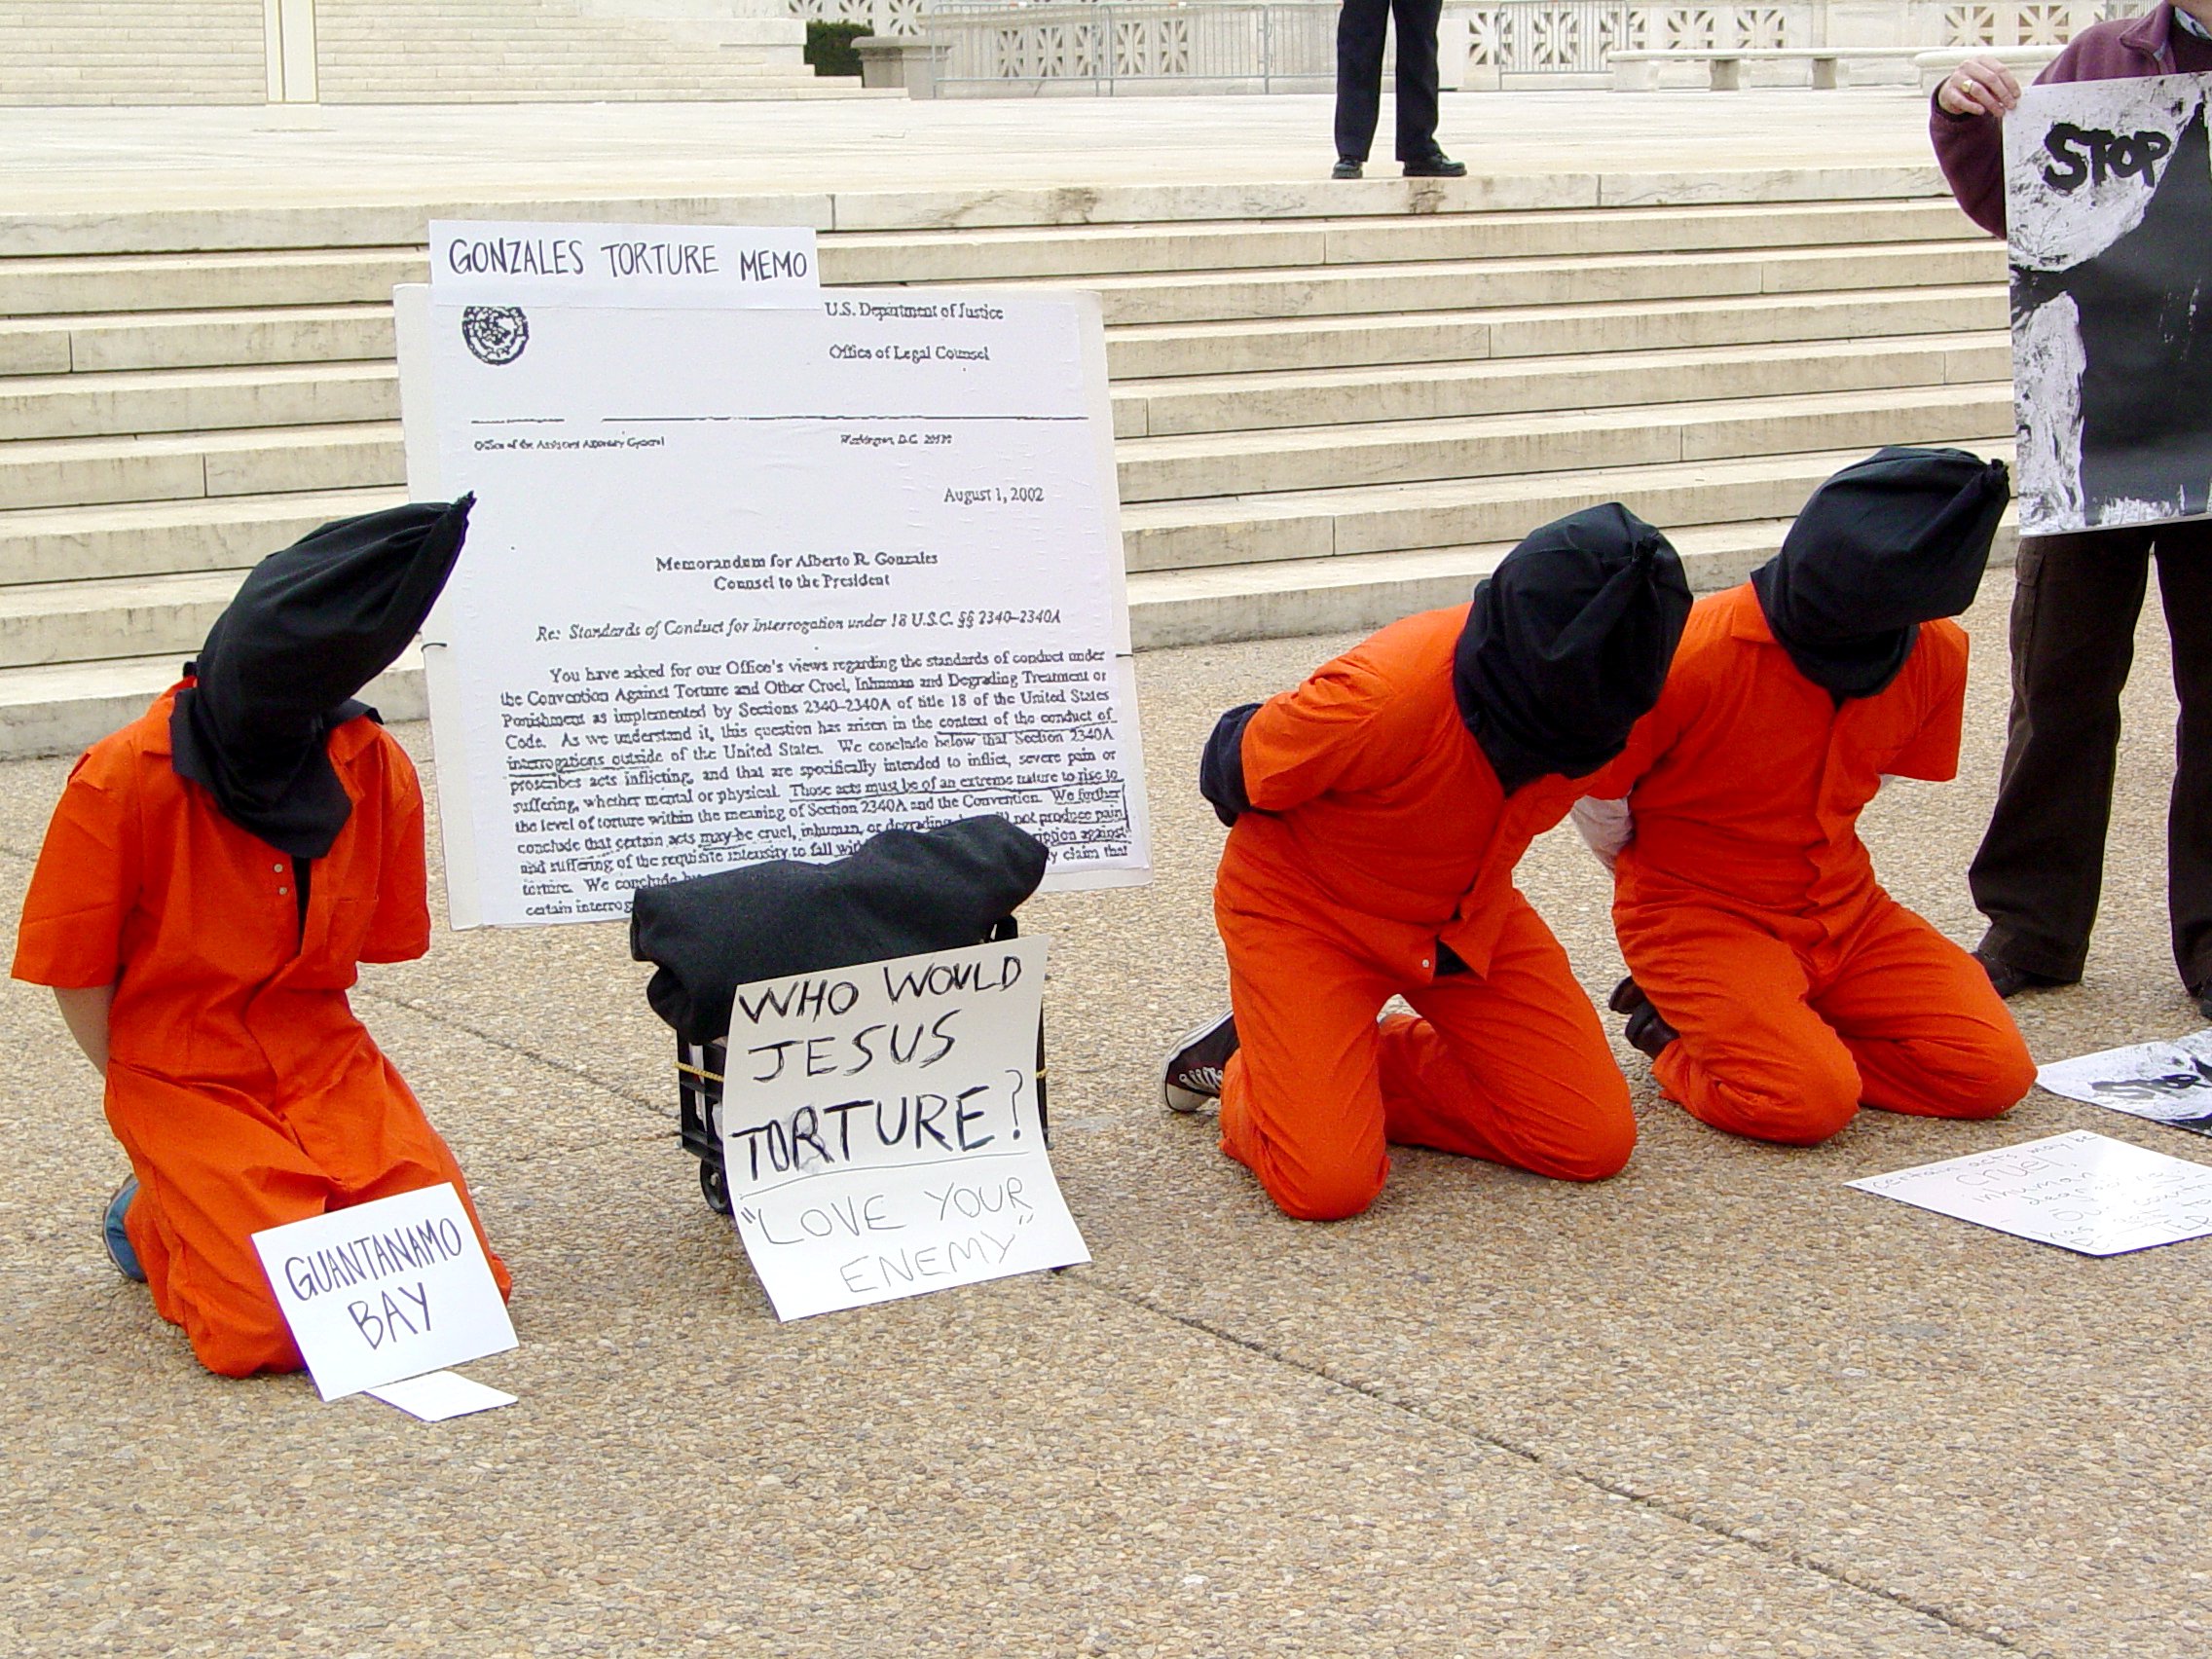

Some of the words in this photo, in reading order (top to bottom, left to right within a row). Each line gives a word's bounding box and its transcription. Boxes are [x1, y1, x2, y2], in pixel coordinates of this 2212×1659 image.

[2043, 121, 2172, 195] STOP
[449, 237, 584, 276] GONZALES
[601, 241, 719, 277] TORTURE
[740, 249, 808, 281] MEMO
[825, 302, 856, 316] U.S.
[859, 302, 937, 321] Department
[940, 303, 957, 318] of
[958, 303, 1004, 319] Justice
[830, 344, 871, 359] Office
[875, 345, 892, 359] of
[895, 346, 931, 363] Legal
[936, 346, 989, 360] Counsel
[943, 488, 991, 505] August
[996, 488, 1008, 504] 1,
[1011, 487, 1044, 502] 2002
[655, 554, 765, 571] Memorandum
[770, 553, 793, 569] for
[796, 553, 849, 569] Alberto
[874, 552, 939, 567] Gonzales
[714, 575, 774, 591] Counsel
[779, 577, 793, 589] to
[796, 574, 819, 589] the
[822, 572, 890, 589] President
[569, 623, 641, 640] Standards
[645, 620, 662, 640] of
[664, 619, 724, 637] Conduct
[726, 617, 749, 637] for
[753, 615, 844, 635] Interrogation
[848, 613, 887, 629] under
[738, 978, 859, 1024] WHO
[883, 955, 1022, 1003] WOULD
[748, 1009, 962, 1082] JESUS
[729, 1069, 1023, 1182] TORTURE?
[924, 1176, 1034, 1222] YOUR
[284, 1217, 462, 1302] GUANTANAMO
[348, 1281, 430, 1350] BAY
